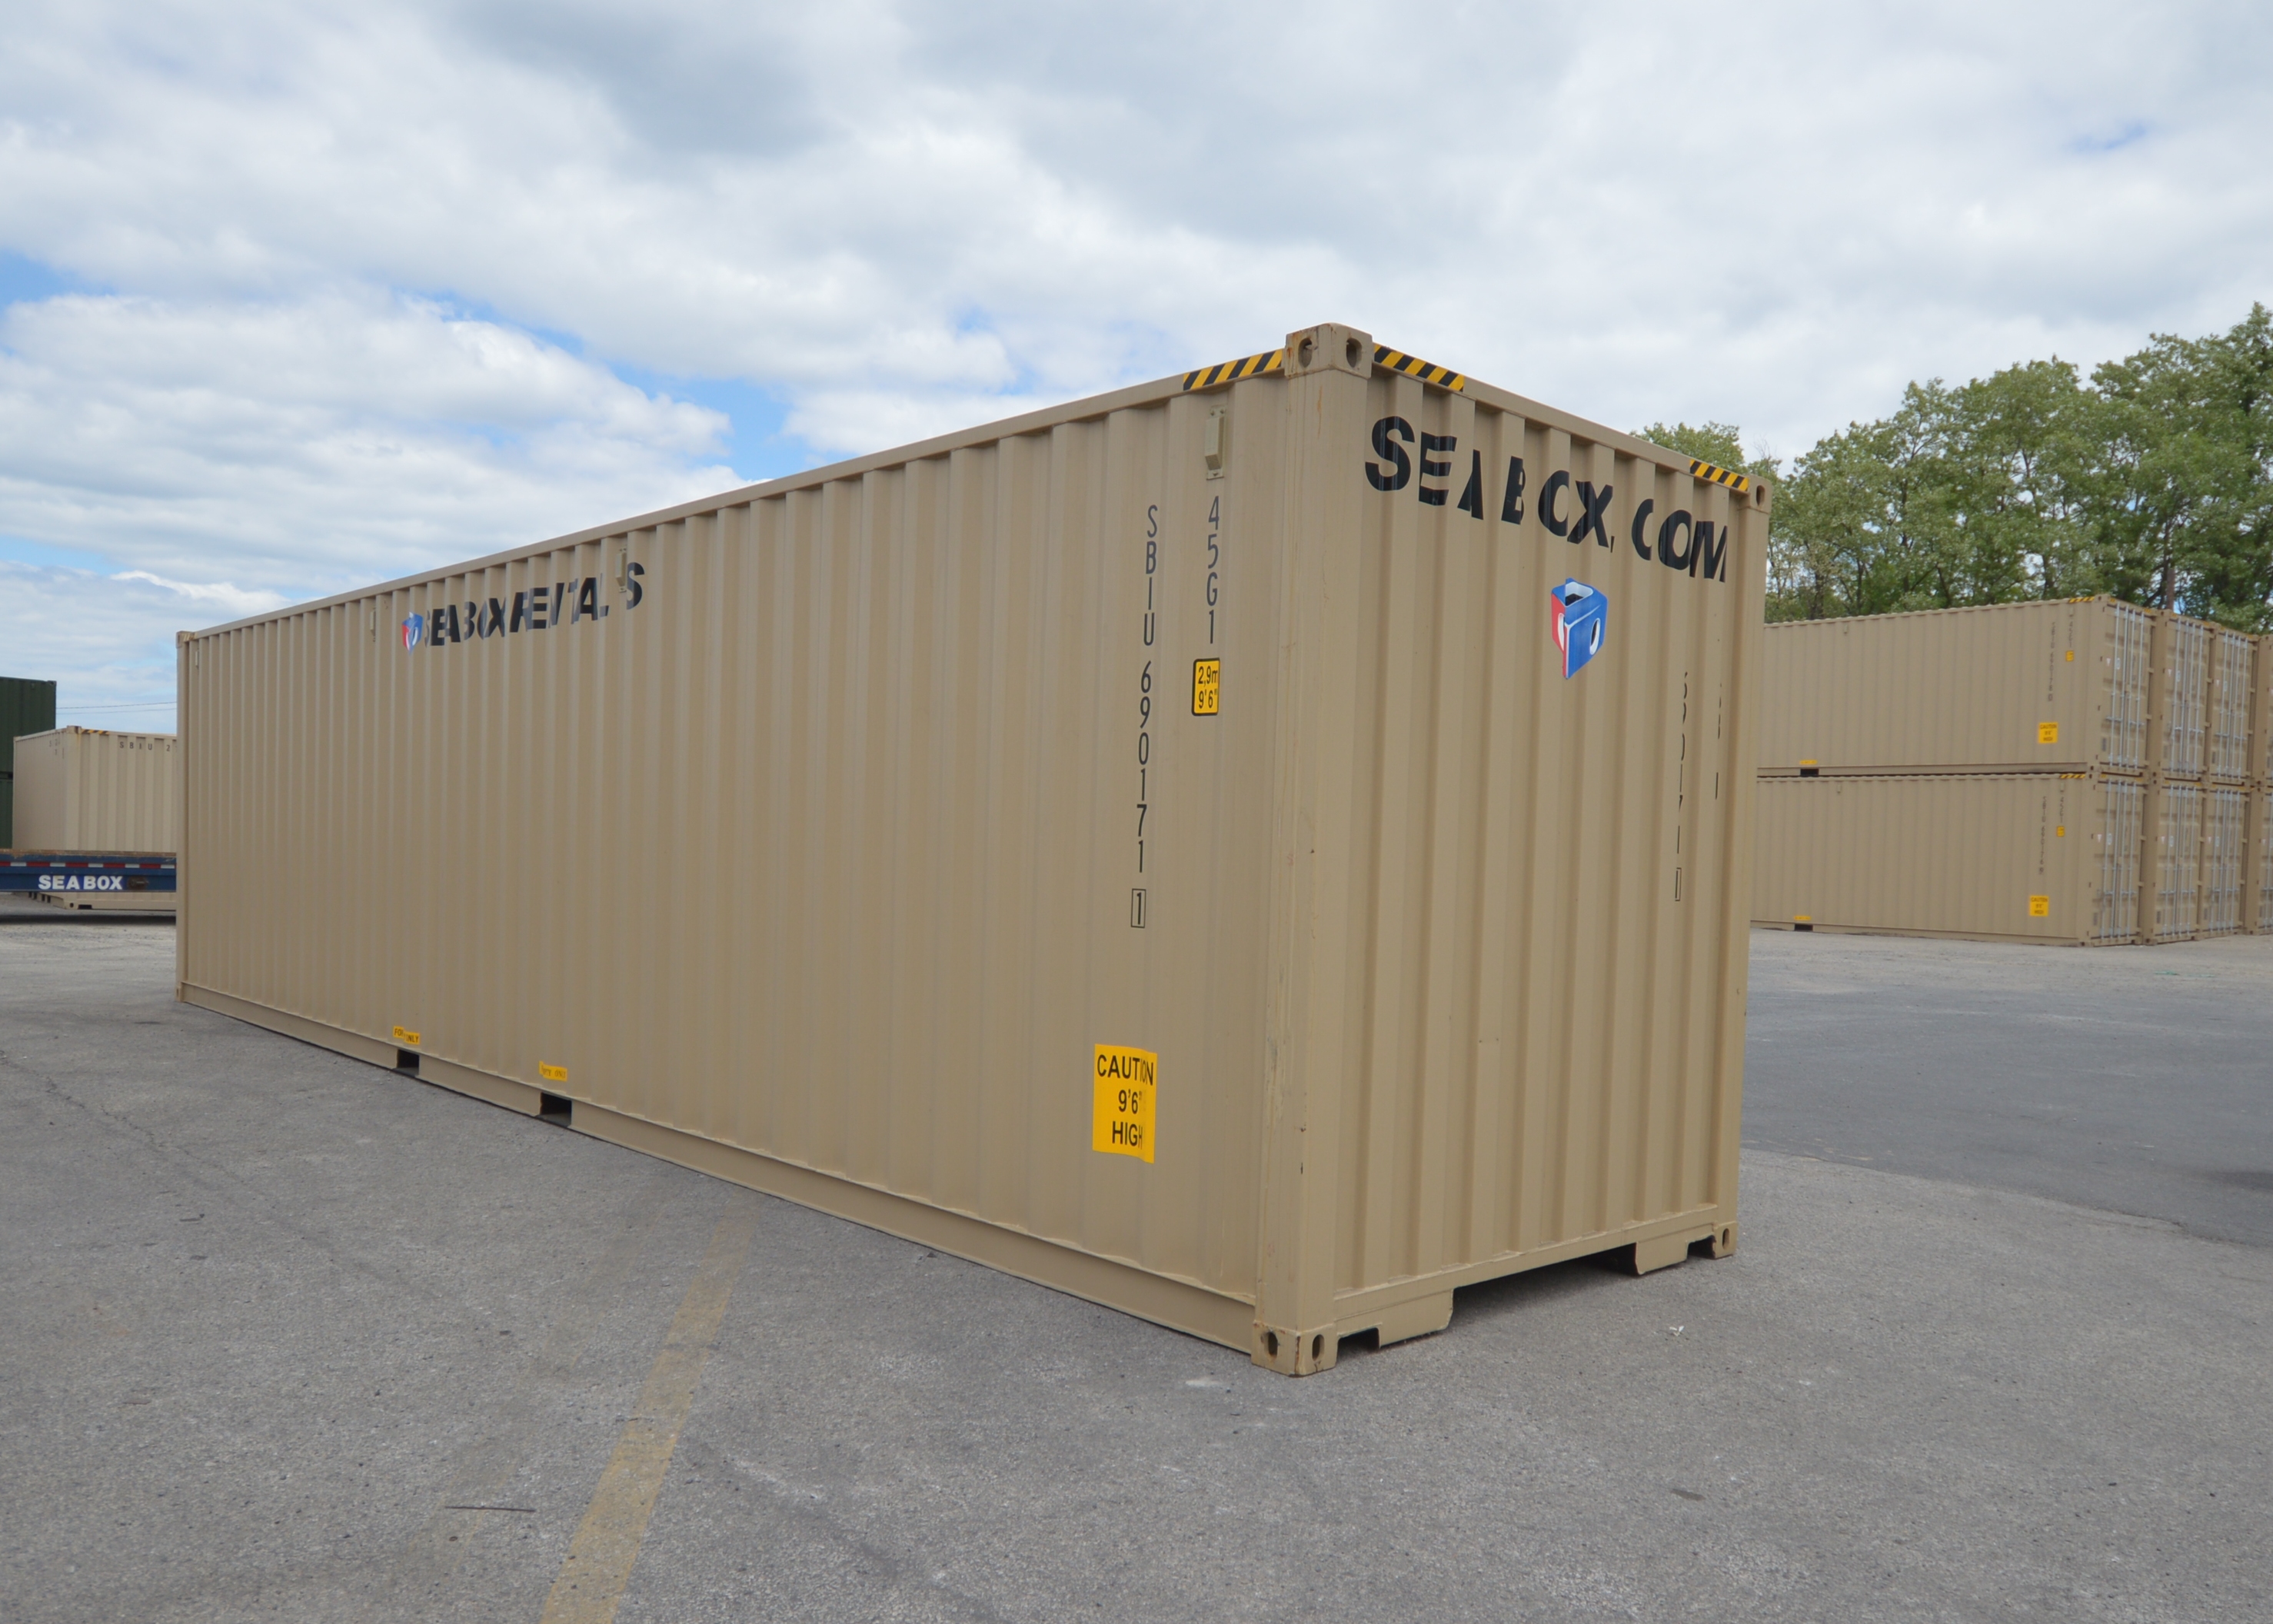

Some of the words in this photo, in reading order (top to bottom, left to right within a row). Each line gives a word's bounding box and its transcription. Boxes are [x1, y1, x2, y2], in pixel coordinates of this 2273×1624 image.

[1143, 504, 1159, 647] SBIU
[1206, 494, 1220, 644] 45G1
[119, 740, 153, 751] SBIU
[1136, 660, 1152, 874] 690171
[38, 874, 80, 890] SEA
[83, 874, 123, 890] BOX
[1097, 1053, 1154, 1087] CAUTION
[1111, 1120, 1143, 1150] HIGH
